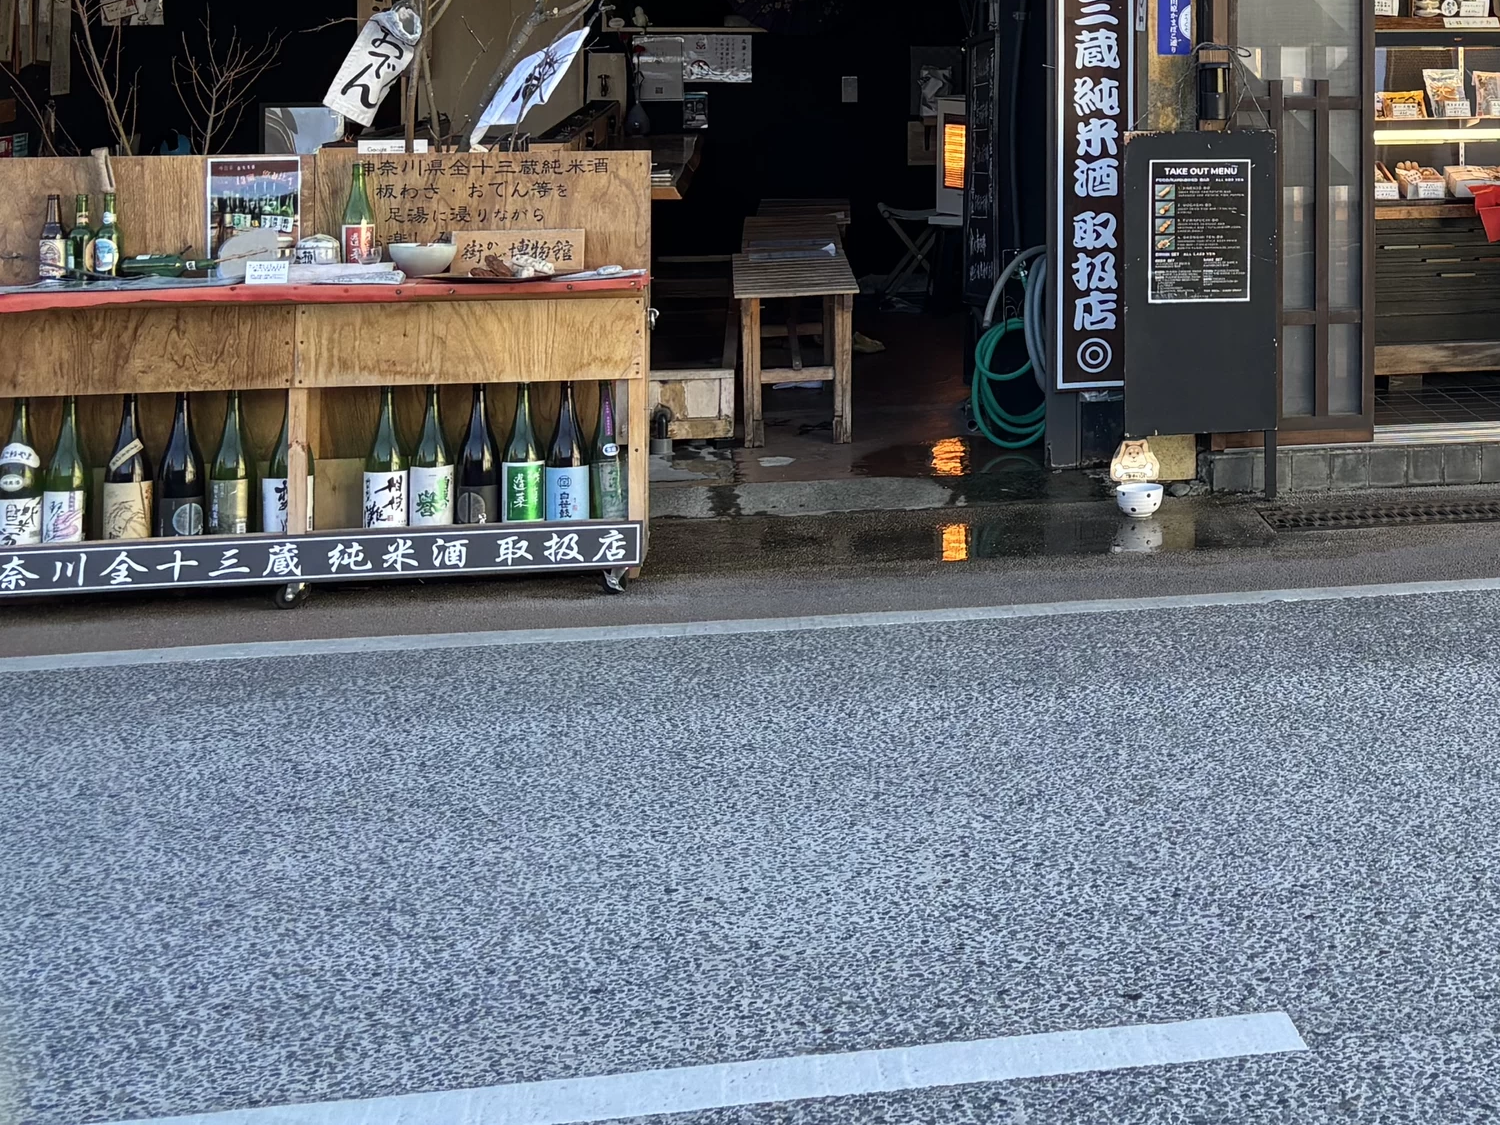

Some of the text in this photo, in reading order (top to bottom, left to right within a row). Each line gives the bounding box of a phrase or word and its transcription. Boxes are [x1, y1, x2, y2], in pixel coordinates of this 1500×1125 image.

[341, 24, 404, 109] おでん
[1164, 166, 1238, 175] TAKE OUT MENU
[388, 206, 545, 224] 足湯に浸りながら
[559, 492, 572, 518] 白笹鼓
